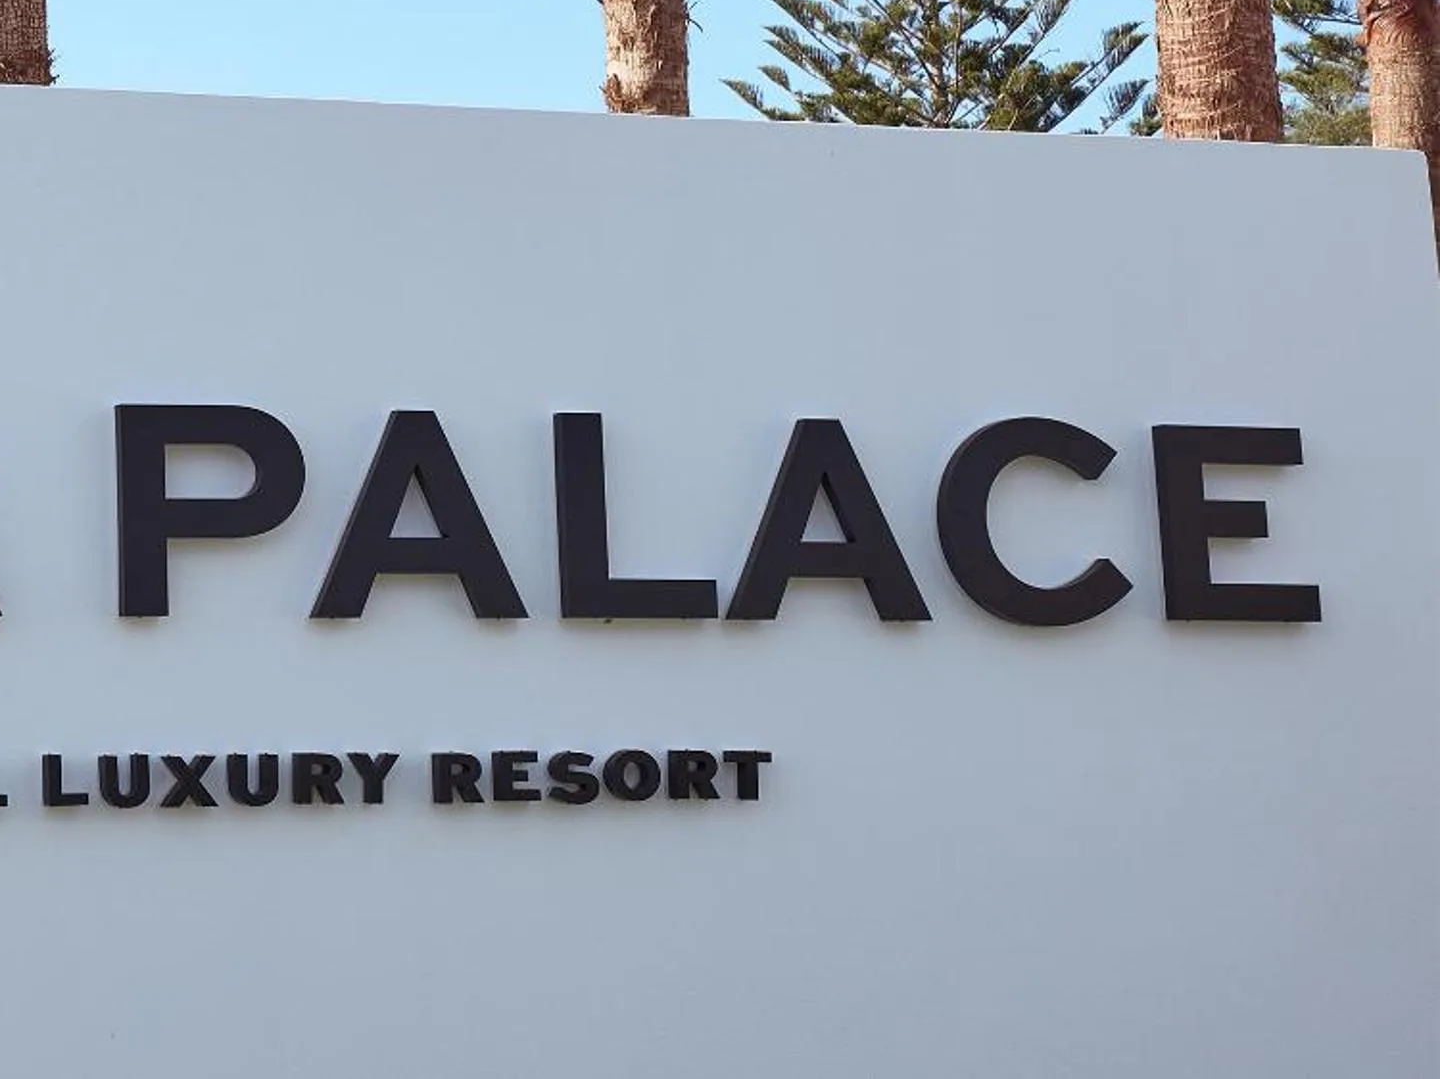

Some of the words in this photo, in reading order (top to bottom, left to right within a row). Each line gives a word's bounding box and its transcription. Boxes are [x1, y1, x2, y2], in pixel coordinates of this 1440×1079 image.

[114, 404, 1323, 627] PALACE
[42, 752, 400, 810] LUXURY
[431, 749, 773, 806] RESORT
